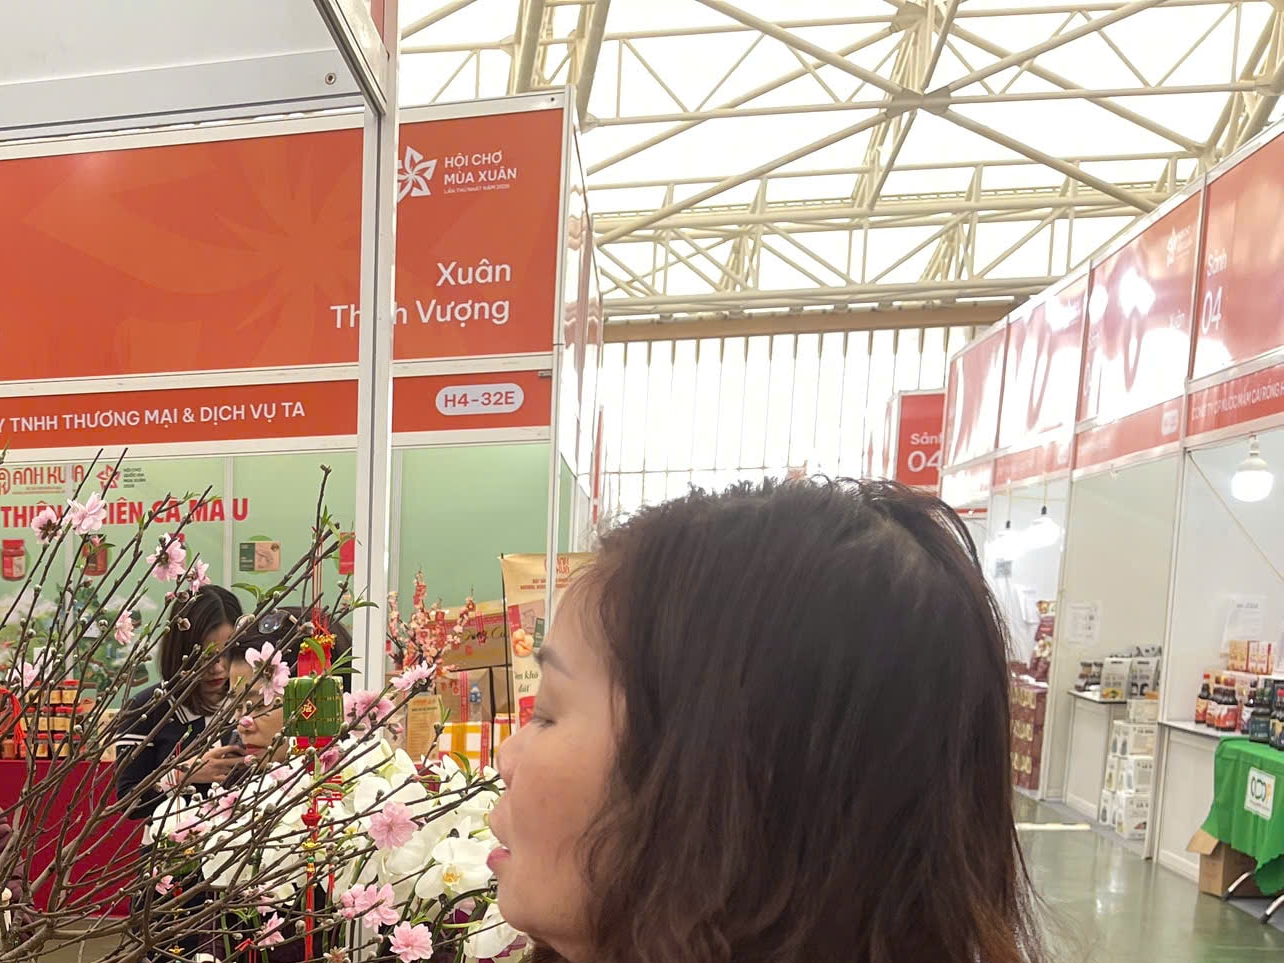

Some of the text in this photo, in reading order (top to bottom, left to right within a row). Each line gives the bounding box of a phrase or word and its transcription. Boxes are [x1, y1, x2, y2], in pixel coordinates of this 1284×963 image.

[444, 150, 502, 169] HỘI CHỢ
[444, 166, 517, 185] MÙA XUÂN
[435, 256, 513, 287] Xuân
[415, 296, 511, 329] Vượng
[1202, 286, 1223, 334] 04
[443, 390, 516, 409] H4-32E
[10, 412, 60, 434] TNHH
[61, 406, 142, 432] THƯƠNG
[145, 406, 178, 430] MẠI
[182, 406, 196, 424] &
[199, 404, 245, 427] DỊCH
[249, 401, 277, 425] VỤ
[280, 400, 306, 419] TA
[908, 450, 943, 472] 04
